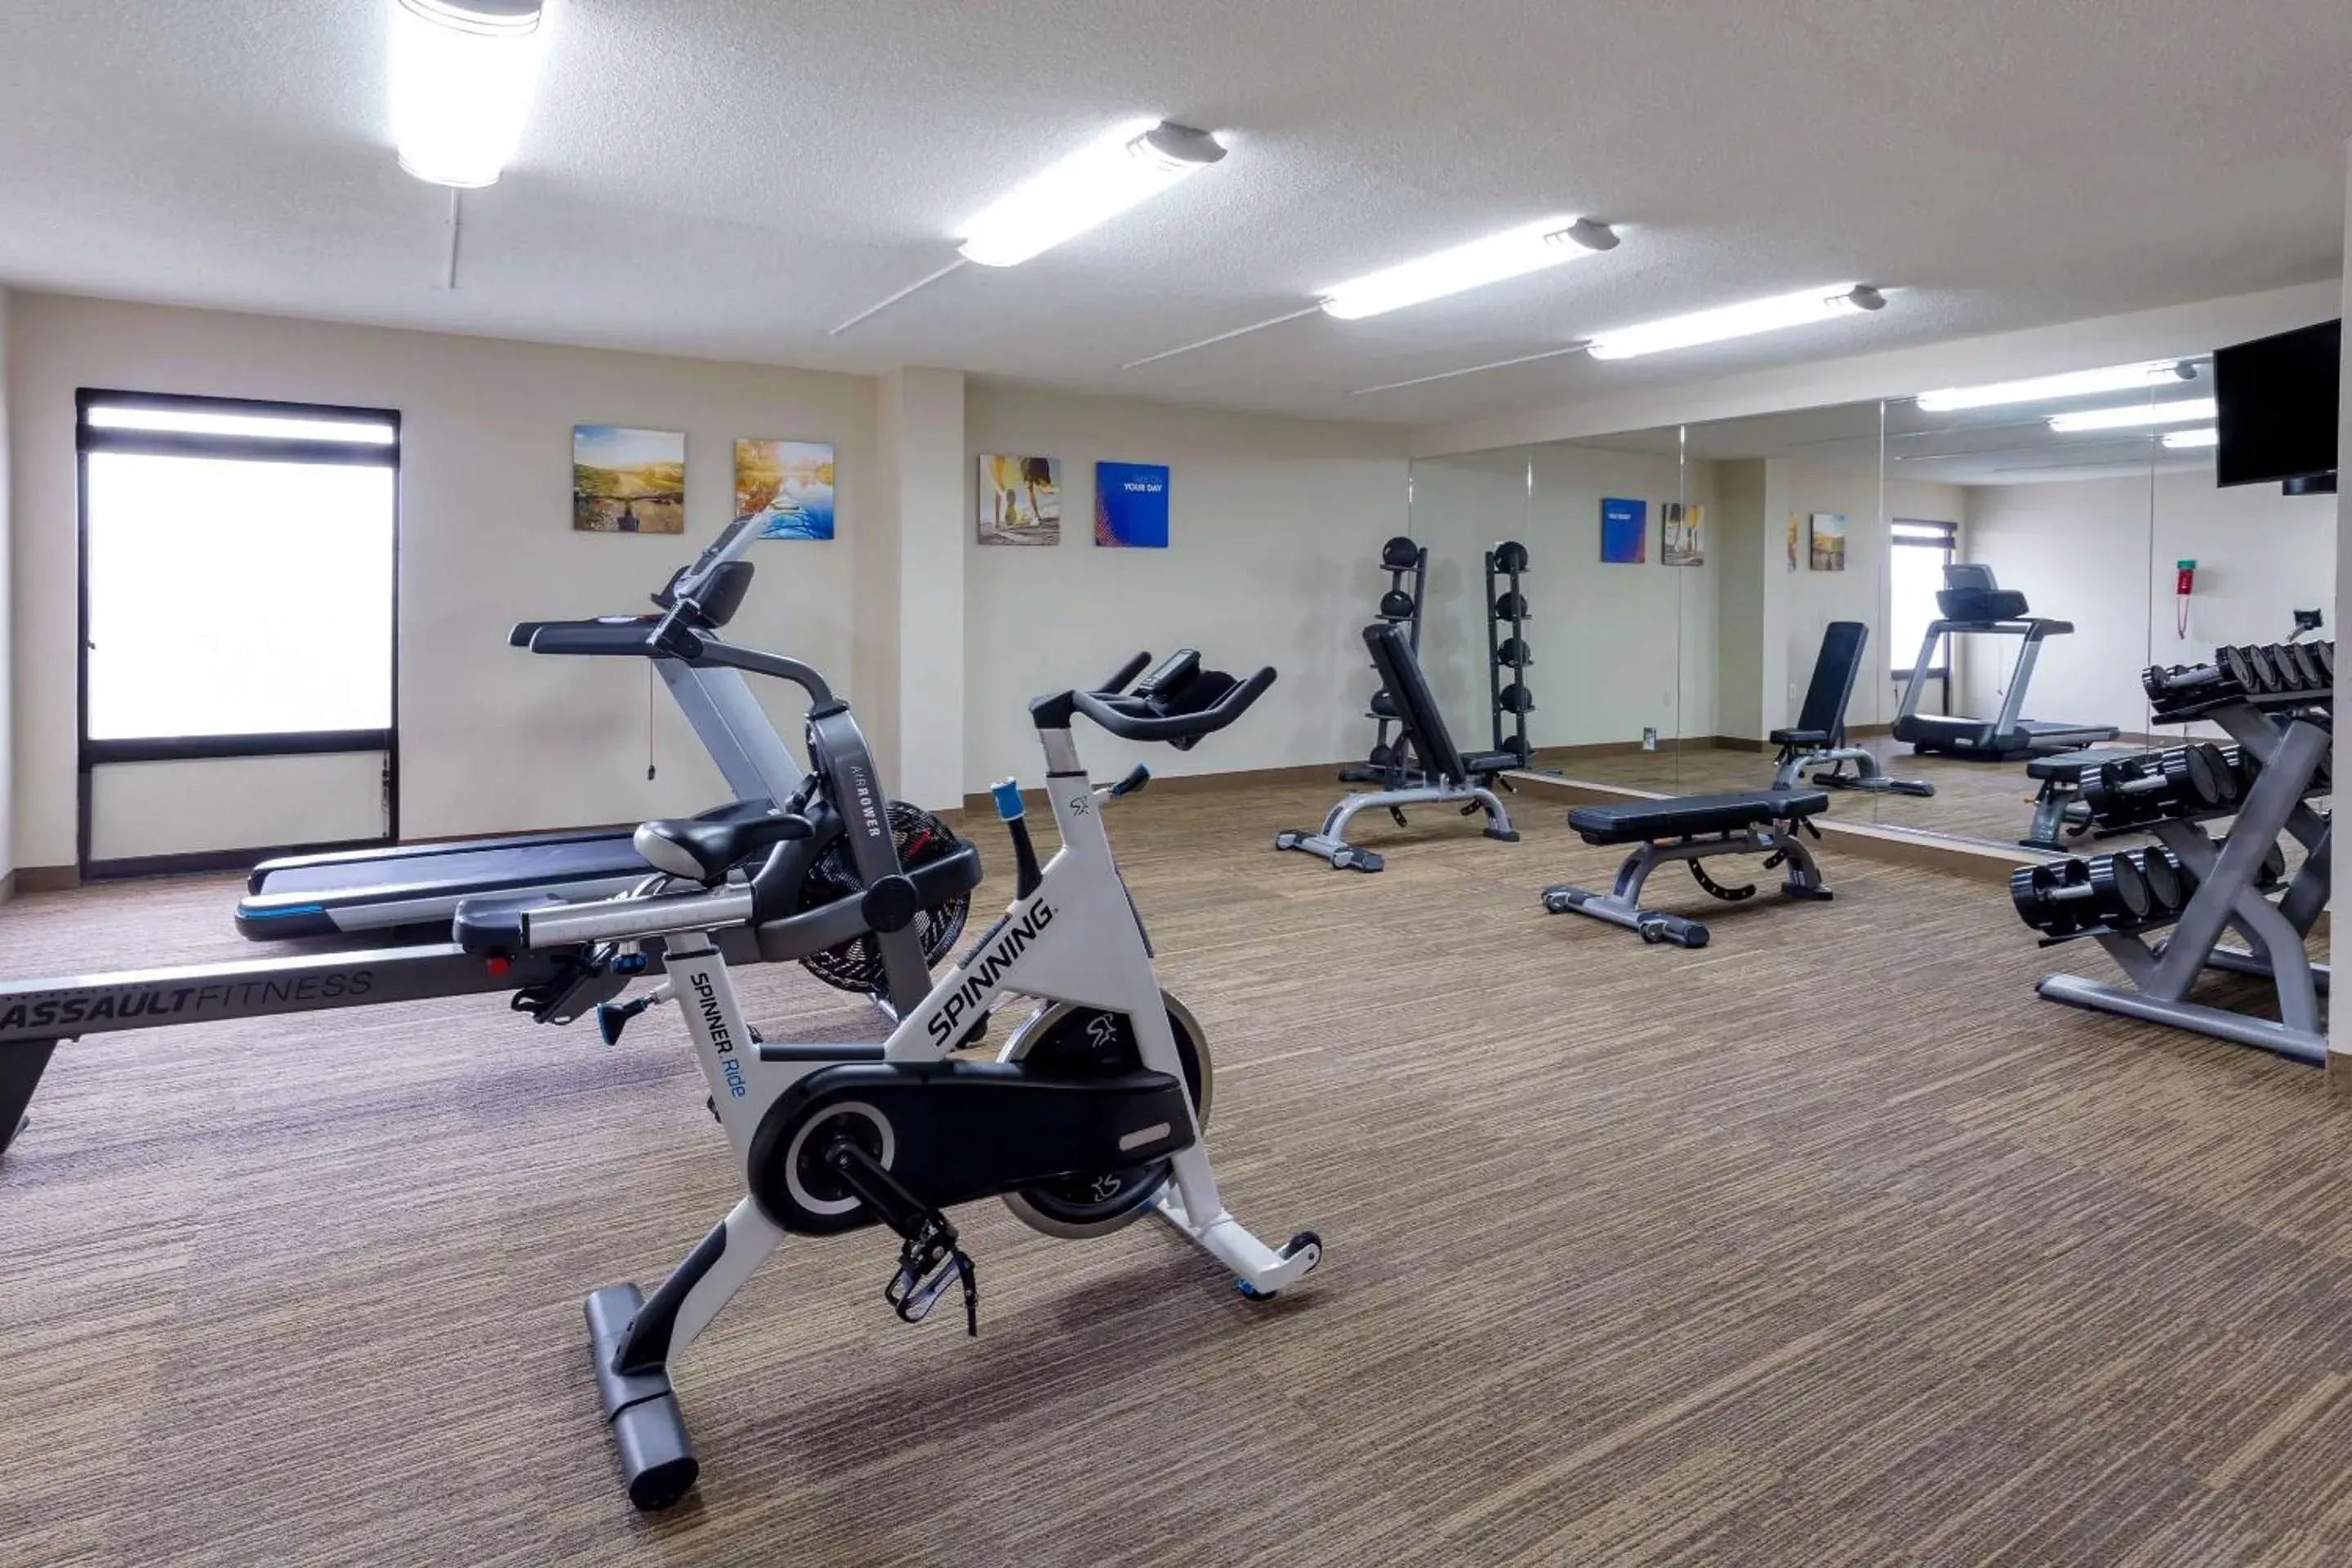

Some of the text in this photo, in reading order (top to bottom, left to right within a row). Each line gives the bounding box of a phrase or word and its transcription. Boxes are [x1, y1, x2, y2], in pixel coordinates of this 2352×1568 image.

[1124, 483, 1163, 492] YOUR DAY
[690, 972, 746, 1098] SPINNER Ride
[928, 898, 1054, 1047] SPINNING
